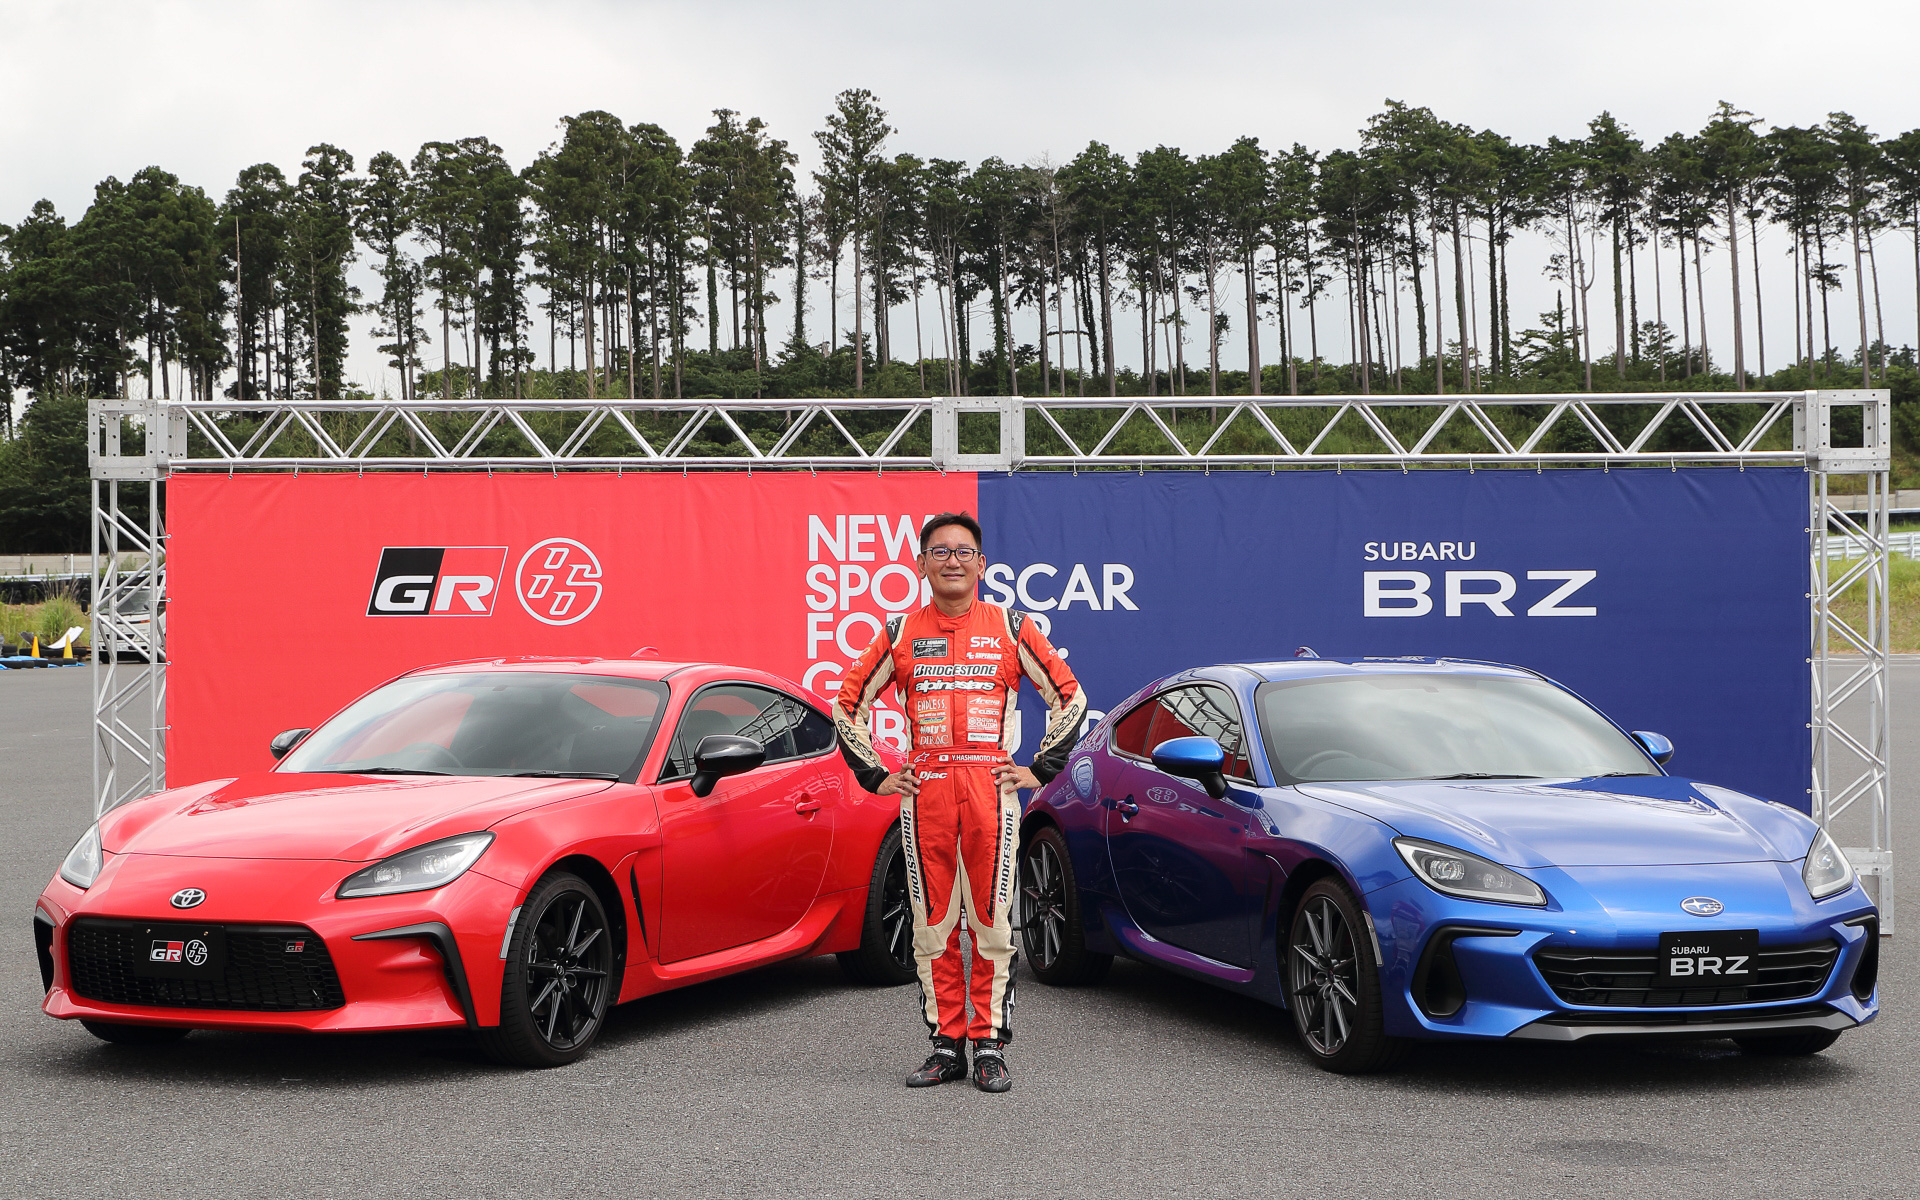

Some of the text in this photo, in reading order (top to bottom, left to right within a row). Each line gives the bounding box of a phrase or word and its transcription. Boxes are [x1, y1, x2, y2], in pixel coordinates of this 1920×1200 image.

[808, 514, 936, 562] NEW
[1364, 541, 1476, 561] SUBARU
[374, 575, 495, 612] GR
[1363, 570, 1597, 617] BRZ
[970, 636, 1002, 649] SPK
[914, 665, 998, 678] BRIDGESTONE
[916, 680, 996, 693] alpinestars
[920, 735, 949, 745] DIRAC
[952, 754, 991, 762] Y.HASHIMOTO
[998, 809, 1014, 904] BRIDGESTONE
[152, 948, 182, 961] GR
[1671, 946, 1710, 955] SUBARU
[1670, 956, 1749, 976] BRZ
